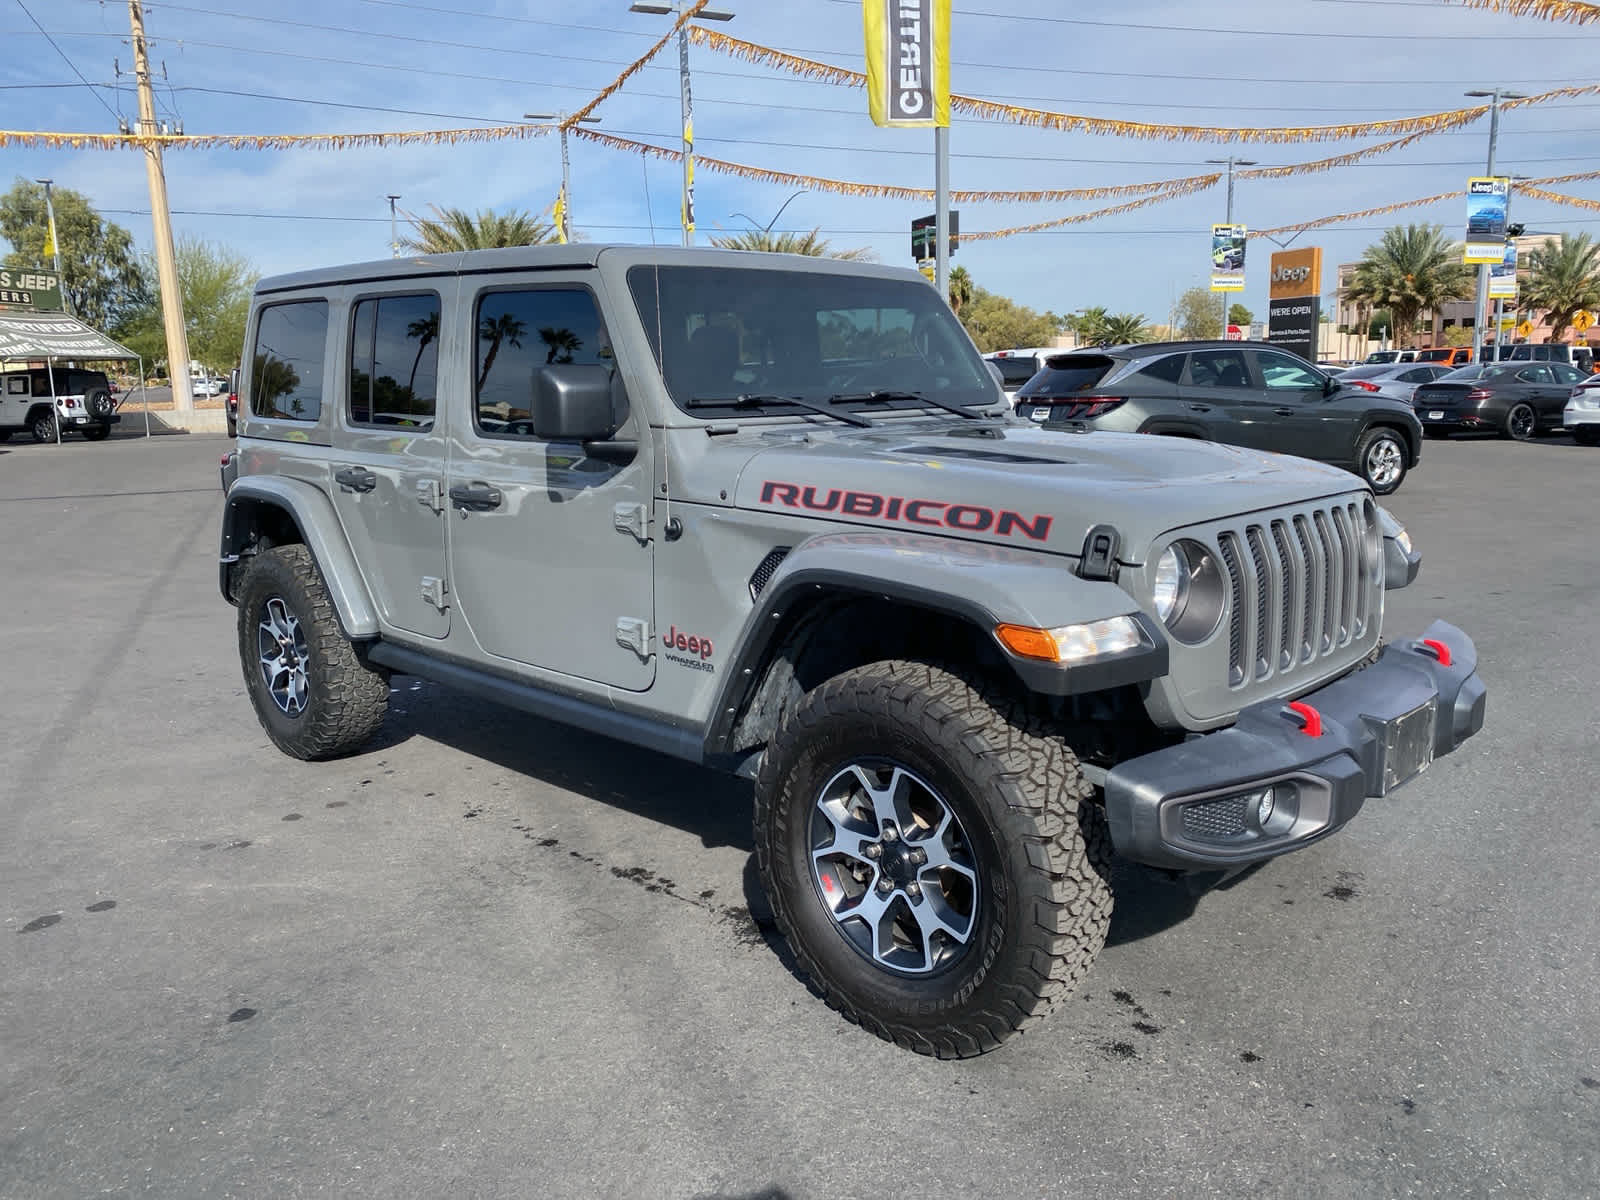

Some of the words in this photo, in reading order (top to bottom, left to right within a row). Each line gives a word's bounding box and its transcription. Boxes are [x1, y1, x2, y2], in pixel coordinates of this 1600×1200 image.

[1473, 182, 1492, 193] Jeep
[1271, 264, 1311, 283] Jeep
[16, 274, 57, 291] JEEP
[1292, 305, 1311, 315] OPEN
[760, 480, 1053, 542] RUBICON
[663, 624, 713, 660] Jeep
[665, 653, 714, 670] WRANGLER
